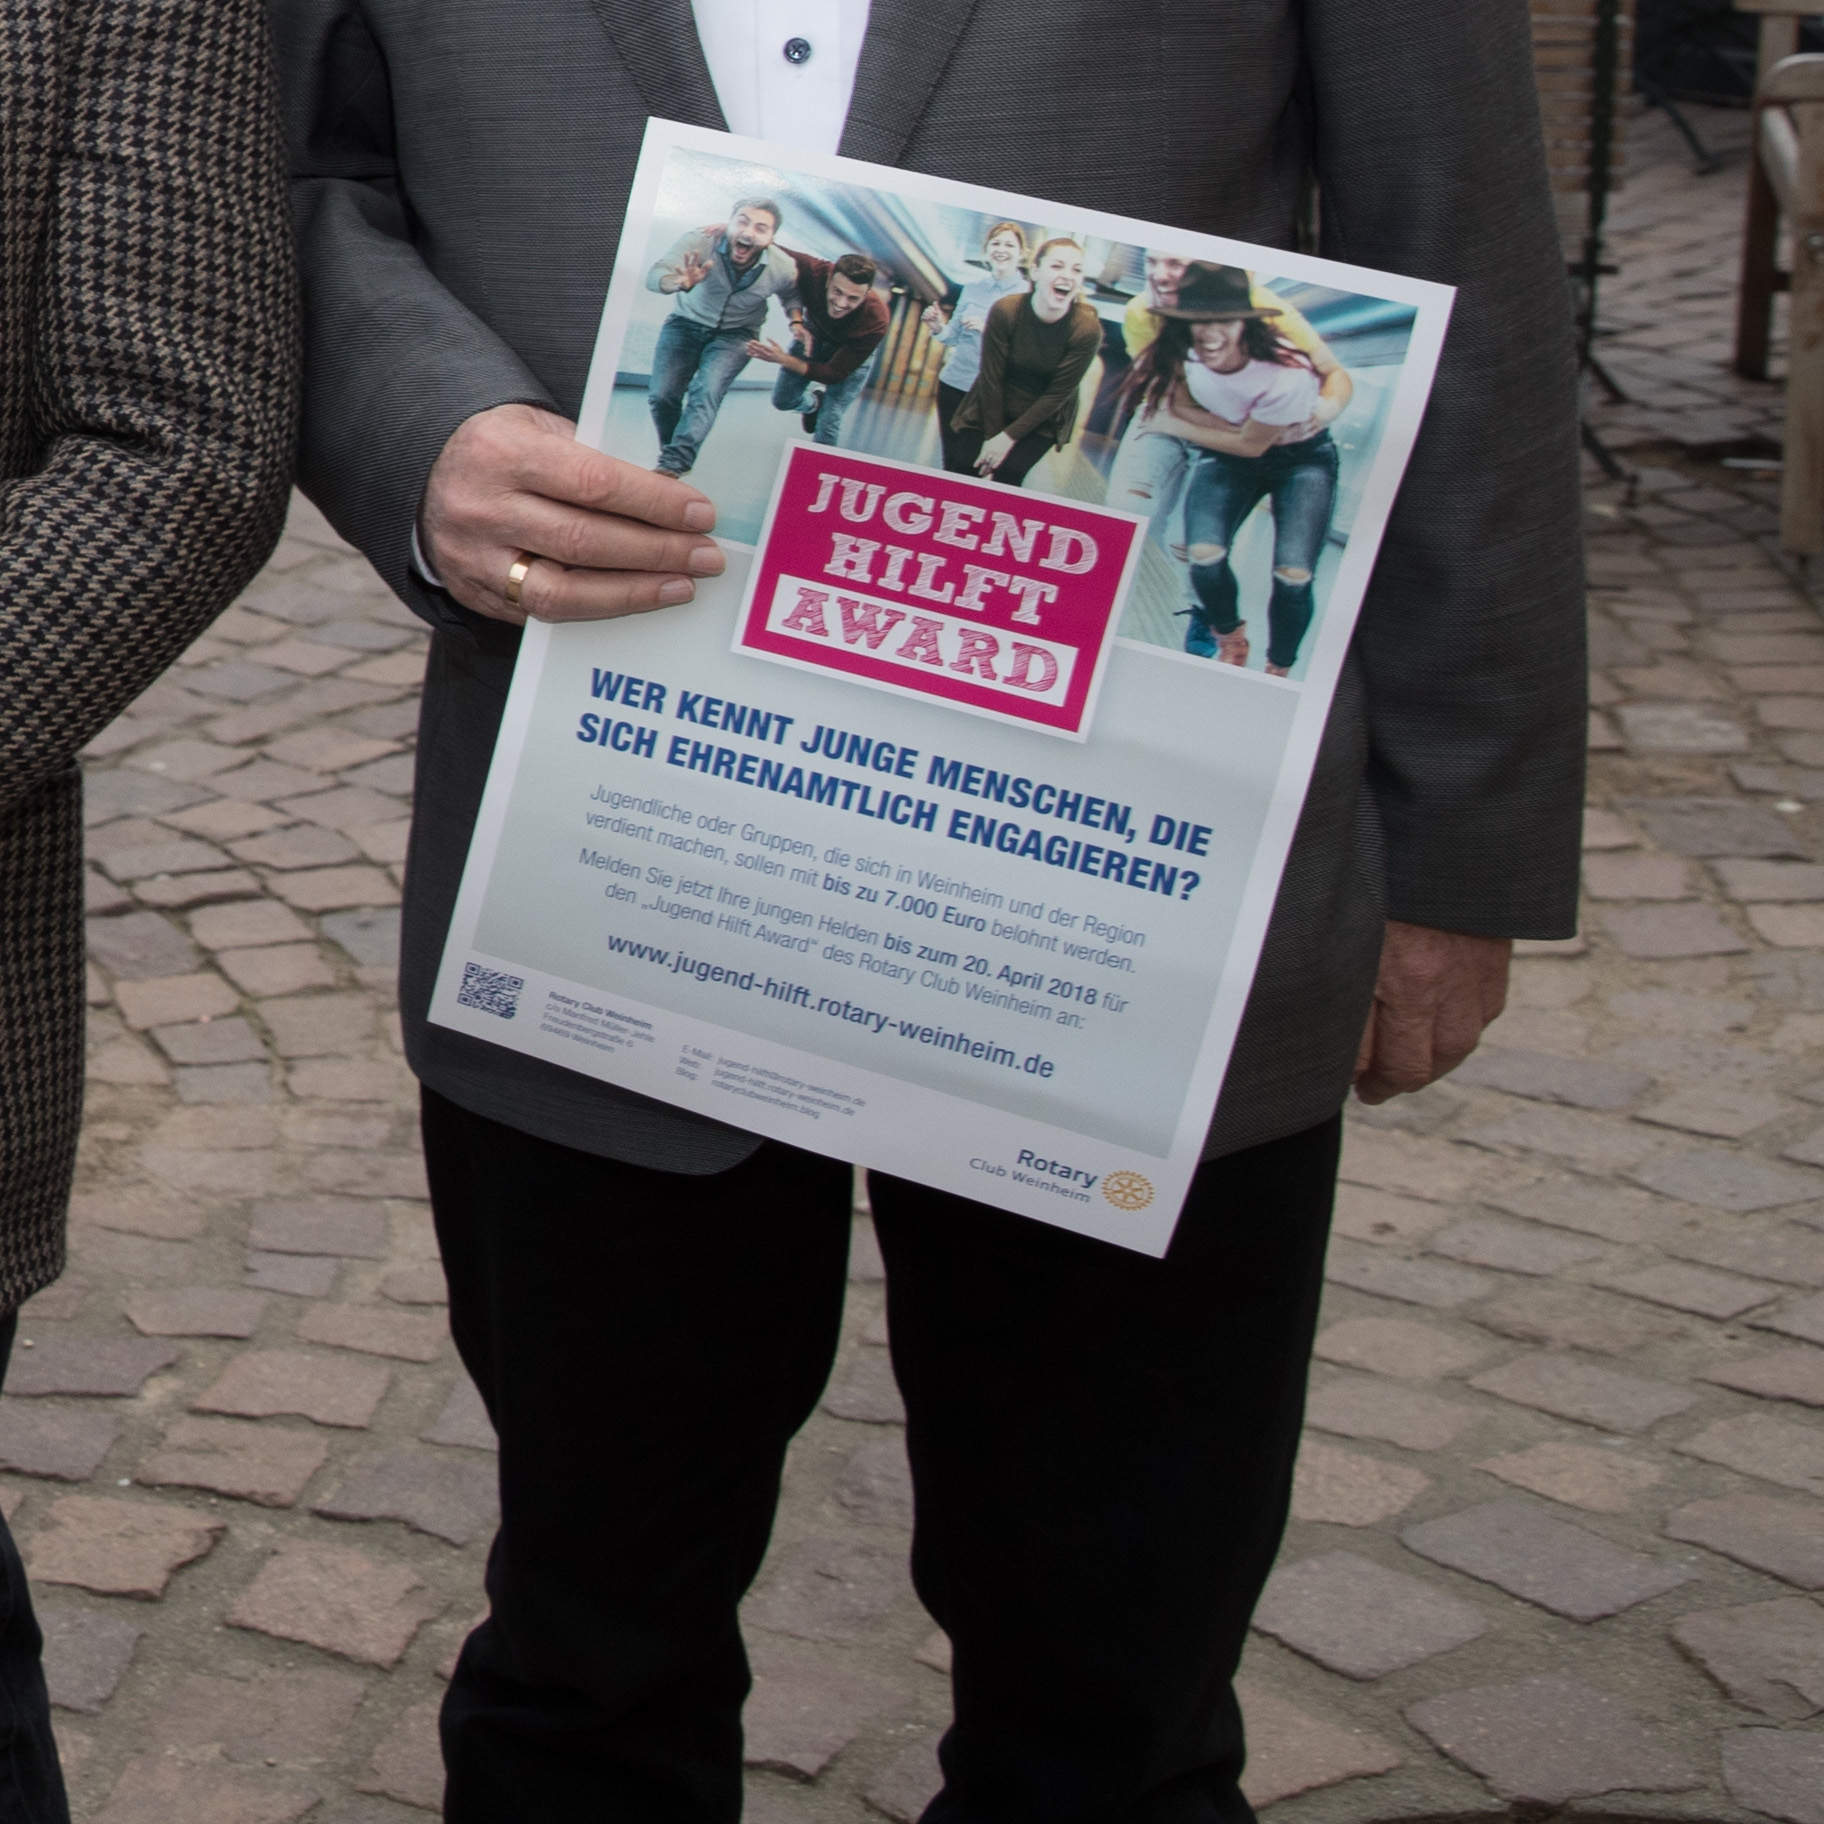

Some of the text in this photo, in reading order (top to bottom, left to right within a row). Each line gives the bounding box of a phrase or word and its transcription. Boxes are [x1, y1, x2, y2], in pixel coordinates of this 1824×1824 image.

[807, 473, 1099, 575] JUGEND
[823, 531, 1059, 626] HILFT
[781, 586, 1059, 693] AWARD
[576, 712, 1201, 901] SICH EHRENAMTLICH ENGAGIEREN?
[591, 667, 1214, 857] WER KENNT JUNGE MENSCHEN, DIE
[578, 847, 1130, 1014] Melden Sie jetzt Ihre jungen Helden bis zum 20. April 2018 für
[586, 812, 1135, 974] verdient machen, sollen mit bis zu 7.000 Euro belohnt werden.
[589, 784, 1147, 948] Jugendliche oder Gruppen, die sich in Weinheim und der Region
[604, 882, 638, 904] den
[716, 912, 753, 938] Hilft
[821, 943, 856, 966] des
[857, 951, 918, 986] Rotary
[919, 969, 961, 996] Club
[965, 981, 1054, 1021] Weinheim
[1055, 1010, 1087, 1030] an:
[608, 935, 1056, 1079] www.jugend-hilft.rotary-weinheim.de
[969, 1157, 1092, 1204] Club Weinheim
[1016, 1148, 1099, 1190] Rotary
